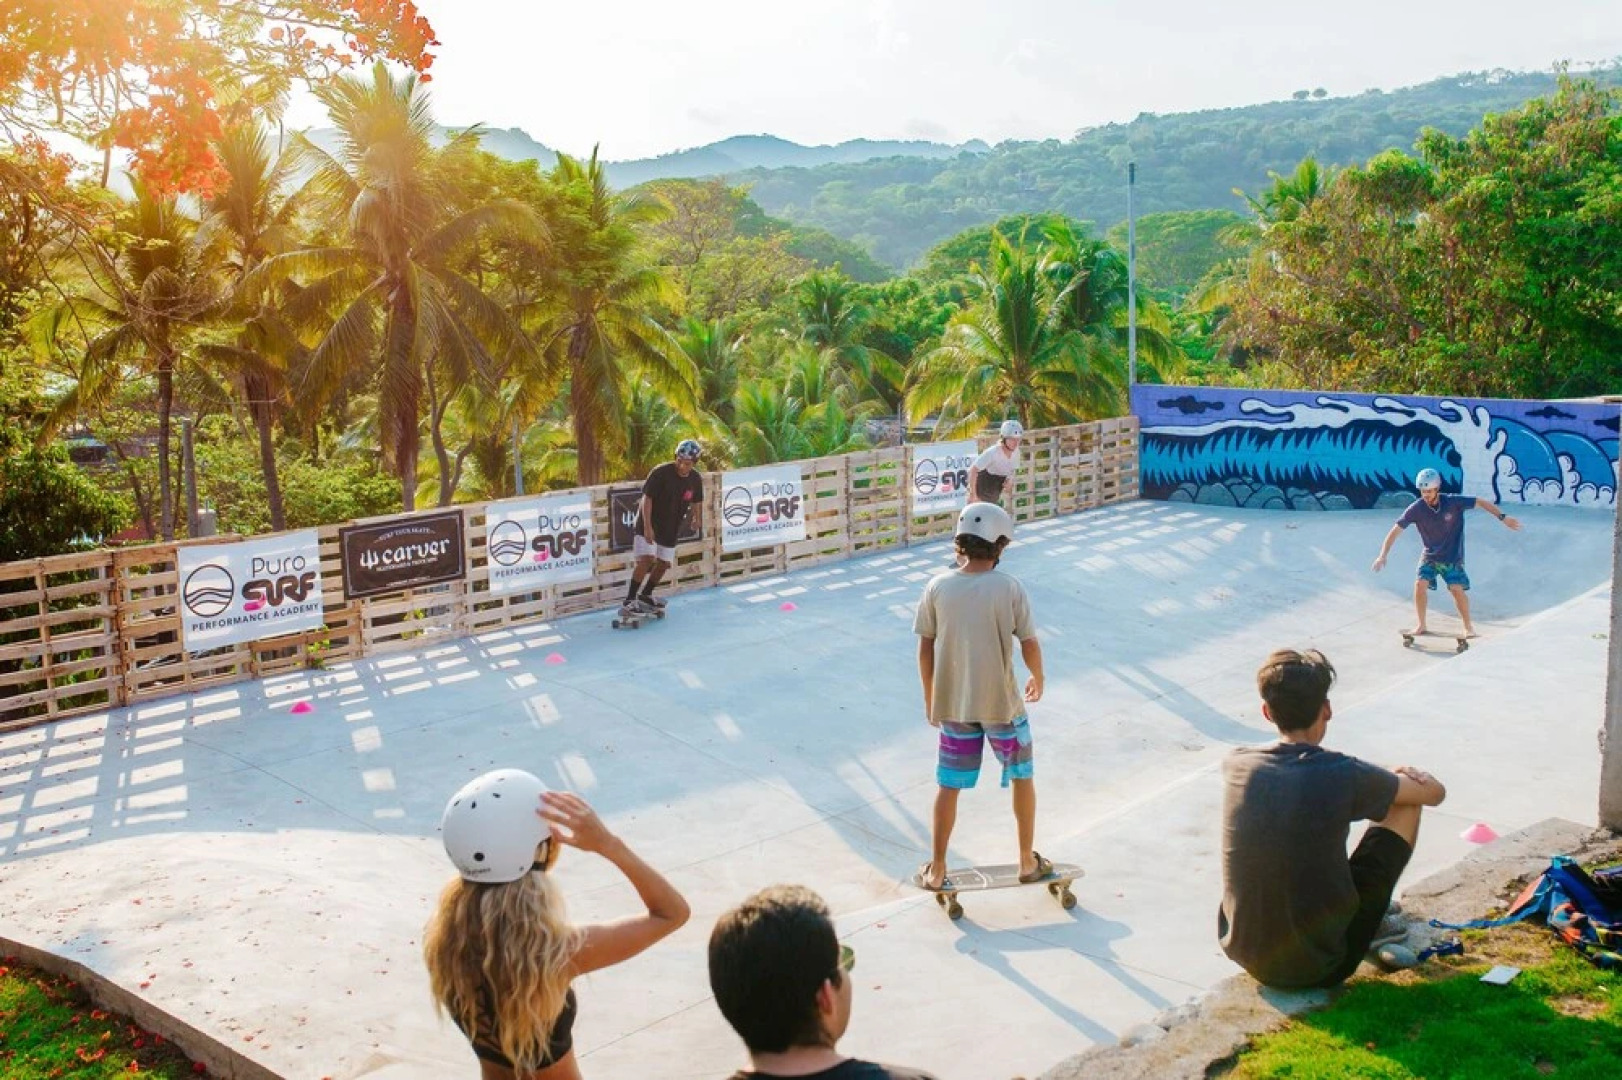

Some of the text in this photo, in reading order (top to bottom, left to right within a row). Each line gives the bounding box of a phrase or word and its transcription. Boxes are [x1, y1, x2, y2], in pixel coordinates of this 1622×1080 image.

[762, 482, 794, 497] Puro
[940, 469, 969, 492] SUR
[756, 495, 801, 524] SURF
[538, 515, 581, 533] Puro
[727, 525, 772, 537] PERFORMANCE
[382, 538, 450, 564] carver
[531, 529, 588, 562] SURF
[252, 555, 306, 578] Puro
[495, 557, 590, 578] PERFORMANCE ACADEMY
[241, 570, 317, 611] SURF
[192, 602, 319, 632] PERFORMANCE ACADEMY
